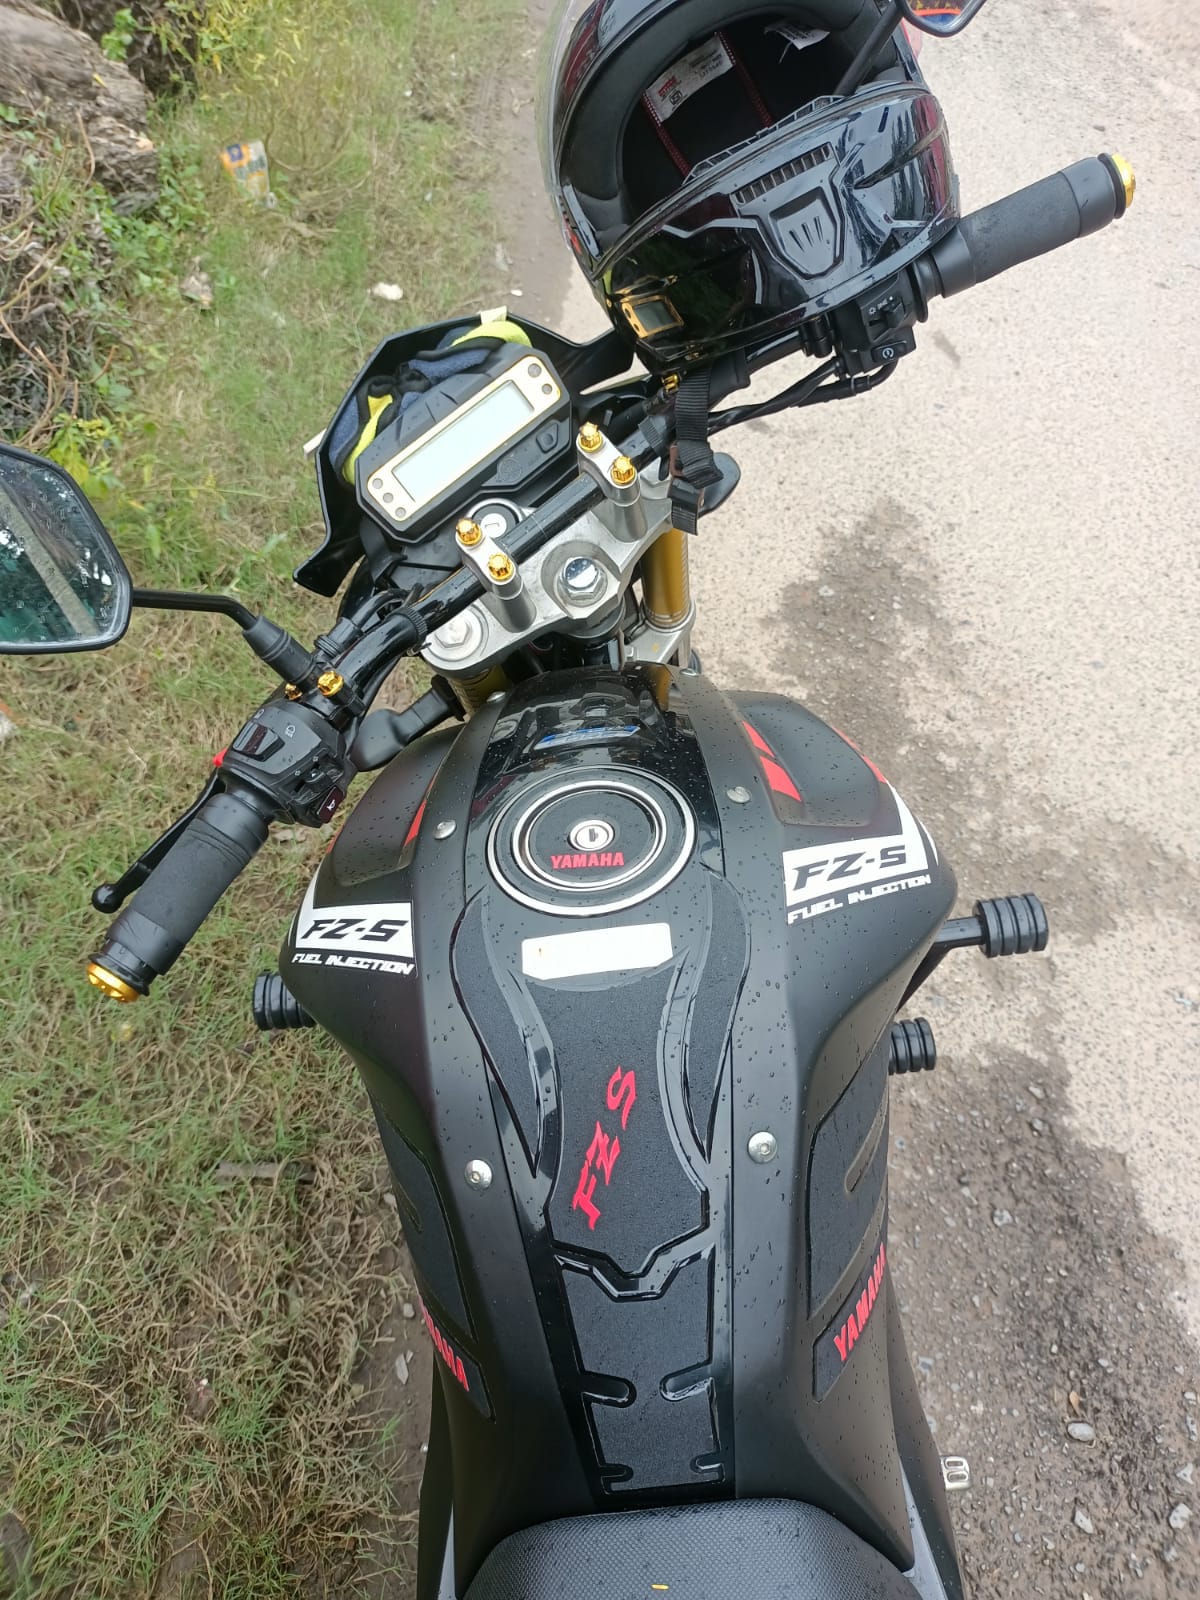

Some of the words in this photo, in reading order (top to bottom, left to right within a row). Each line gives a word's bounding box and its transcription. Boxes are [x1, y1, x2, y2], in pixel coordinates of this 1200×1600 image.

[551, 852, 625, 870] YAMAHA
[792, 845, 907, 891] FZ-S
[787, 898, 844, 925] FUEL
[847, 874, 932, 905] INJECTION
[301, 919, 409, 942] FZ-S
[291, 953, 323, 965] FUEL
[325, 955, 415, 975] INJECTION
[833, 1241, 887, 1361] YAMAHA
